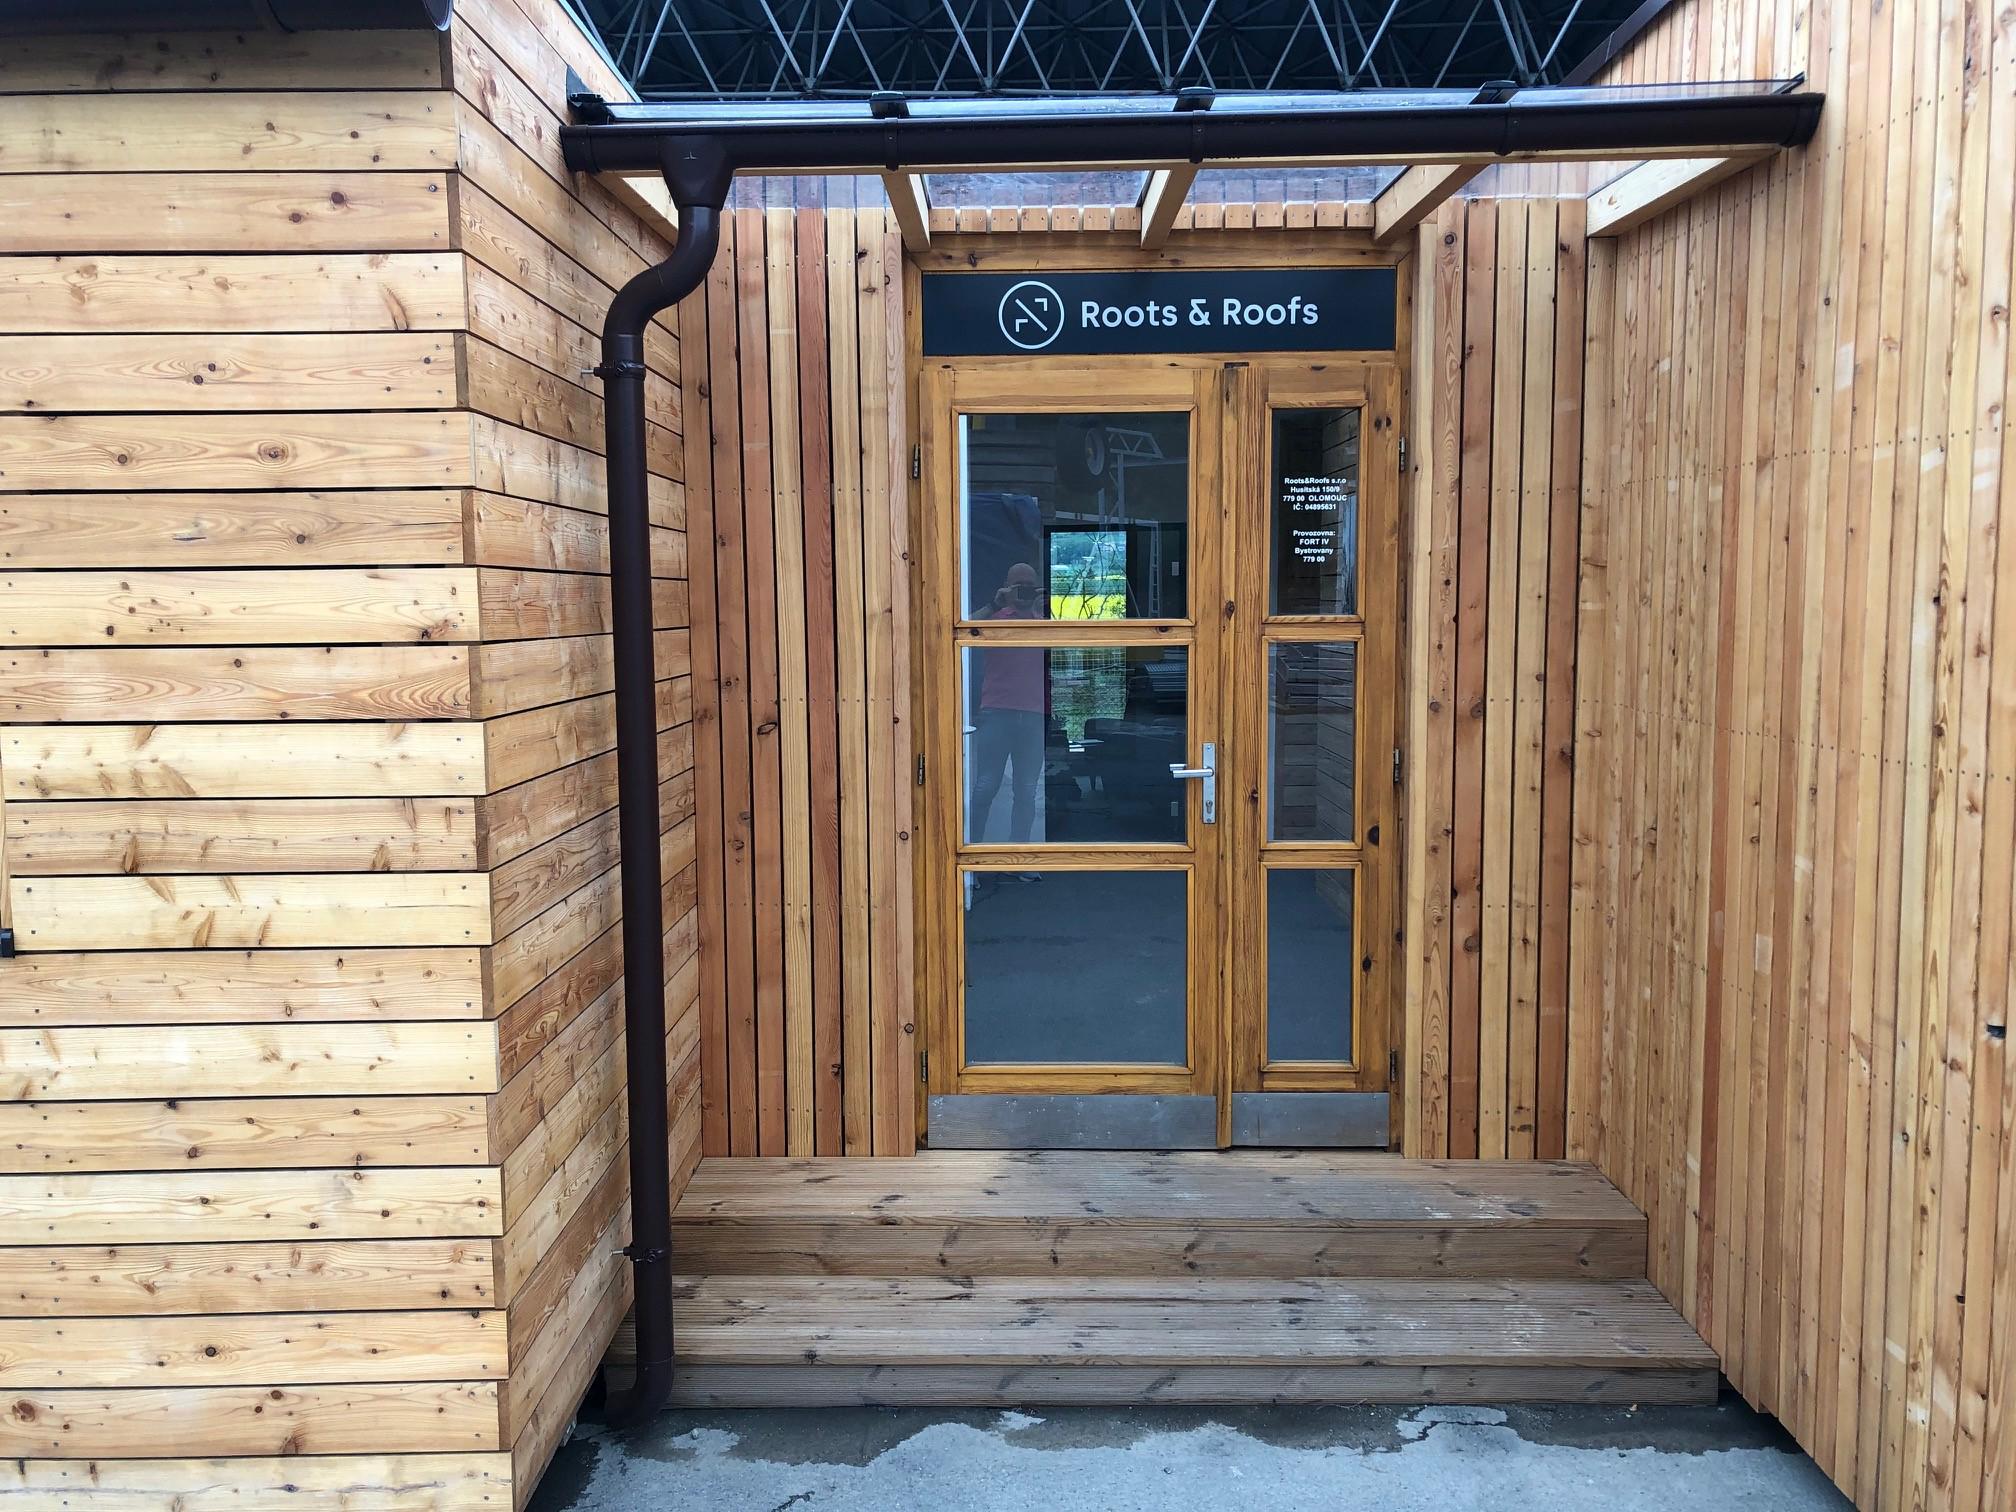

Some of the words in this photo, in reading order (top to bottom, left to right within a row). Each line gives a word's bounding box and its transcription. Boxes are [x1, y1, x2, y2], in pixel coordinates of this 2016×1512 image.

[1081, 300, 1178, 328] Roots
[1188, 298, 1211, 326] &
[1223, 296, 1319, 326] Roofs
[1308, 494, 1348, 502] OLOMOUC
[1293, 503, 1304, 511] IČ:
[1294, 547, 1334, 555] Bystrovany
[1303, 555, 1315, 563] 779
[1316, 555, 1326, 563] 00
